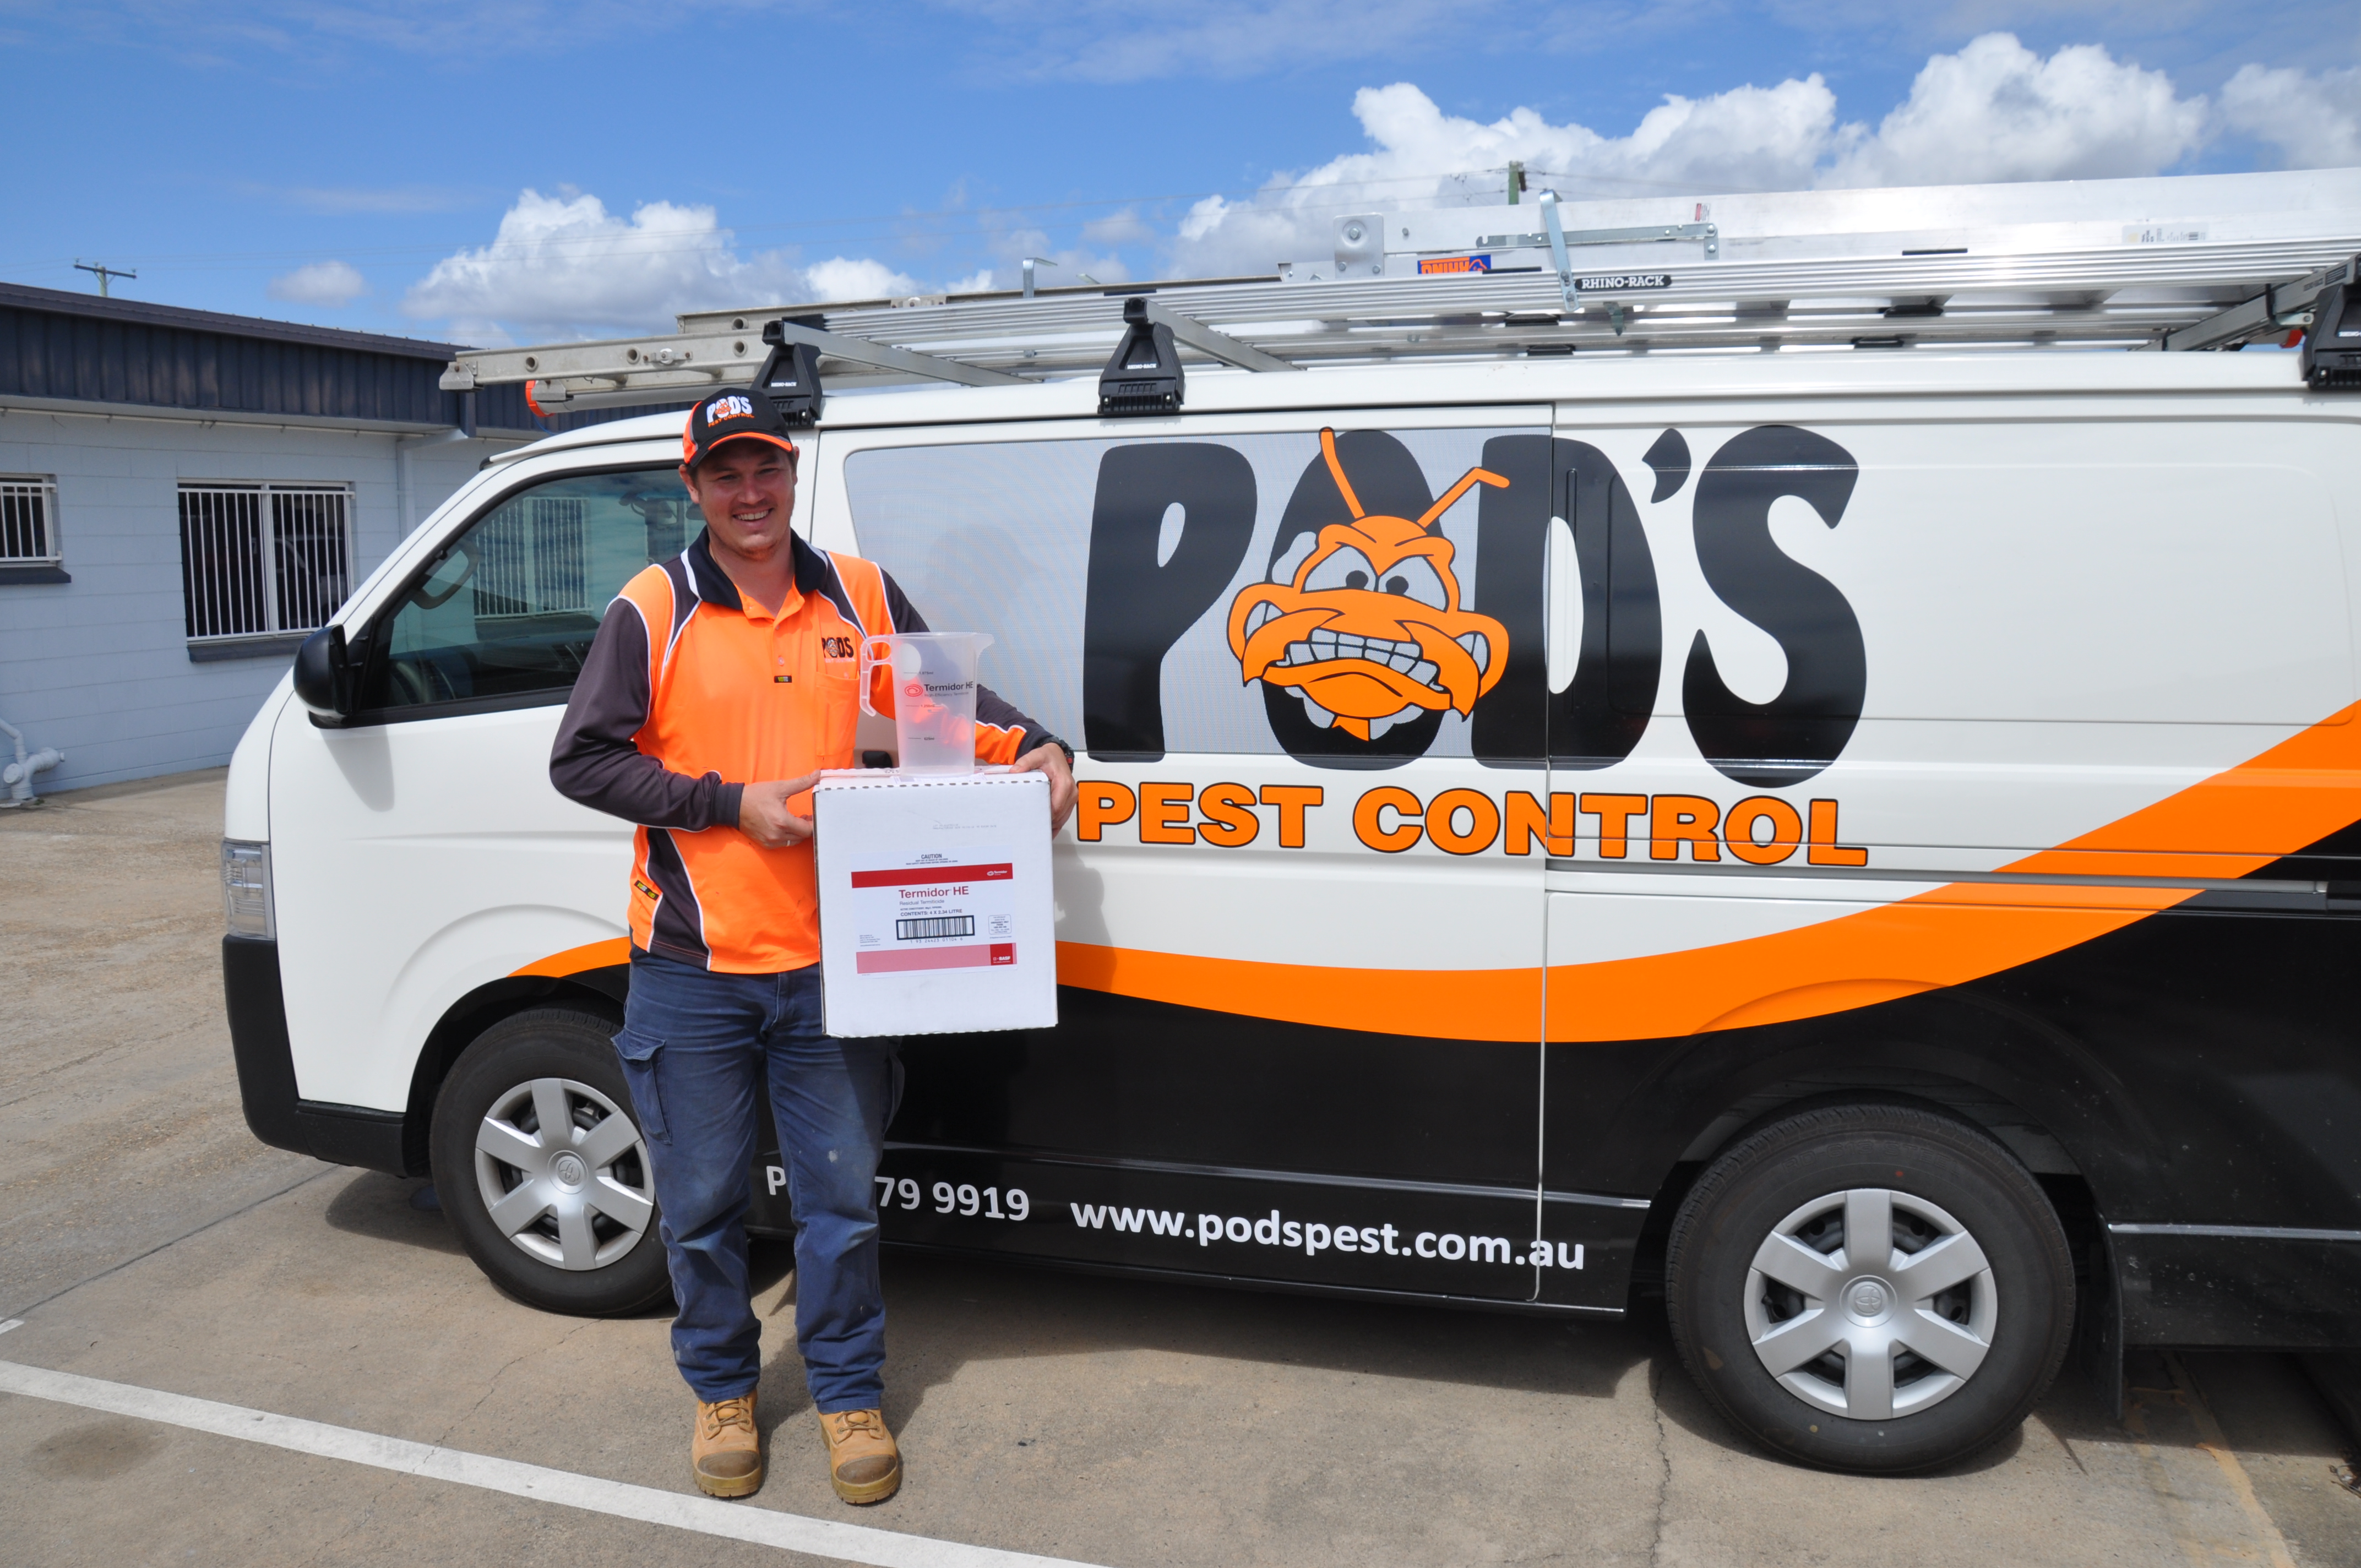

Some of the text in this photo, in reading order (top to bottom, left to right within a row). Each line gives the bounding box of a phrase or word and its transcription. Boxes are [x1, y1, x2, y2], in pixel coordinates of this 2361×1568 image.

[1581, 275, 1664, 290] RHINO-RACK
[708, 412, 755, 428] PEST CONTROL
[1083, 425, 1868, 788] POD'S
[924, 680, 973, 692] Termidor HE
[1077, 781, 1869, 867] PEST CONTROL
[898, 886, 969, 899] Termidor HE
[932, 1182, 1029, 1221] 9919
[1070, 1202, 1585, 1270] www.podspest.com.au
